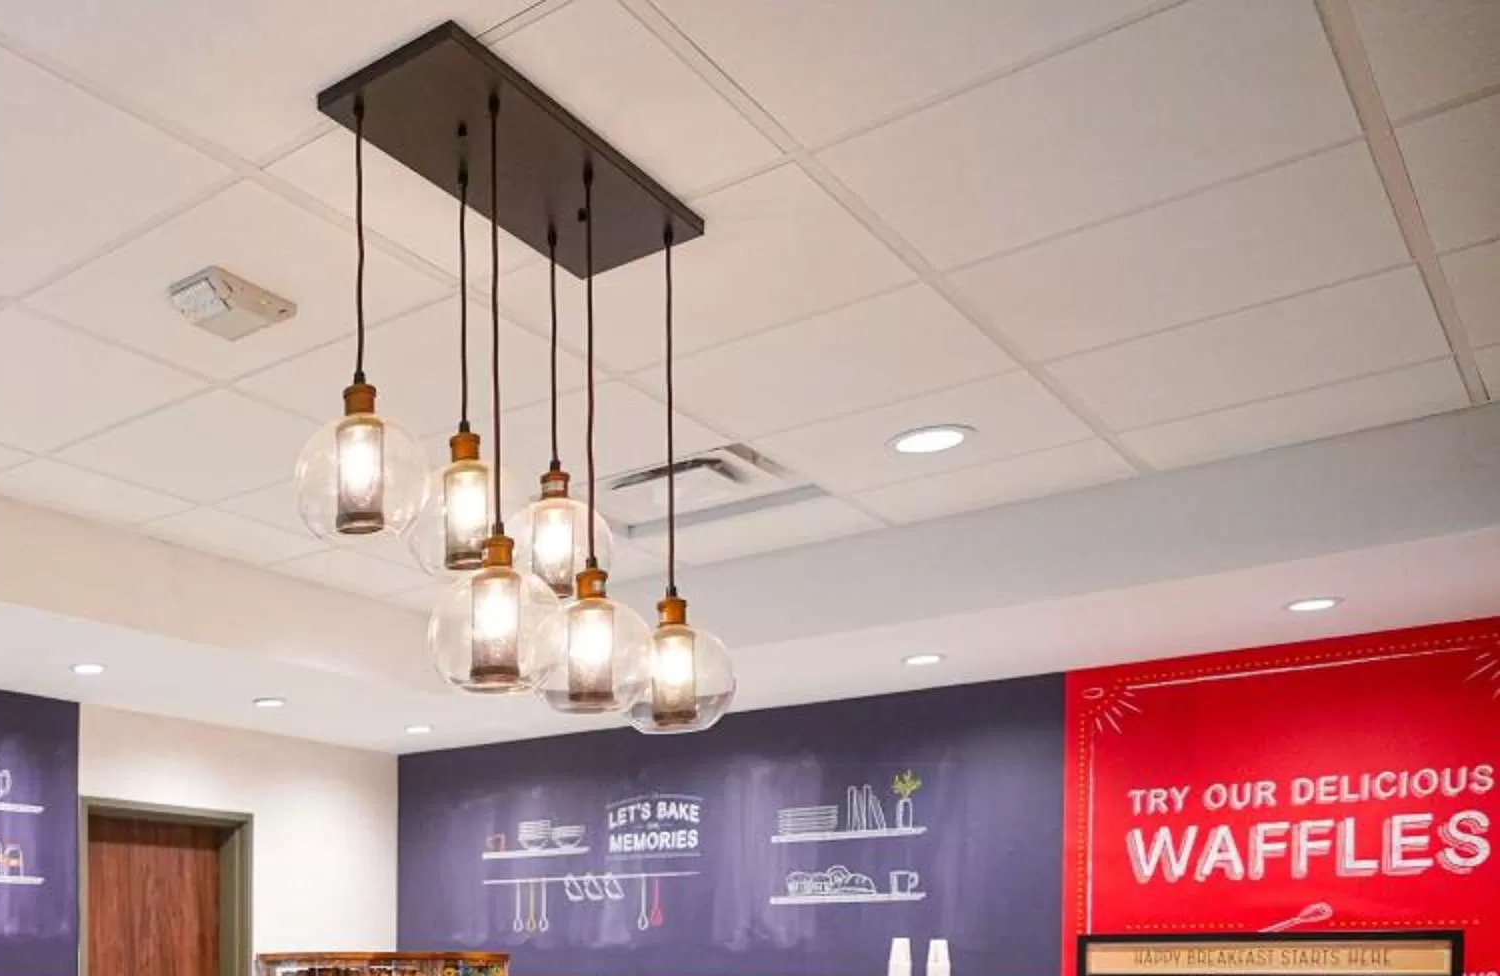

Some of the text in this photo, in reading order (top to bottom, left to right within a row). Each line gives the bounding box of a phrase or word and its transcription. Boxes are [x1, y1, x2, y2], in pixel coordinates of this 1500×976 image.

[1128, 764, 1495, 815] TRY OUR DELICIOUS
[608, 801, 700, 829] LET'S BAKE
[609, 829, 699, 853] MEMORIES
[1125, 809, 1492, 884] WAFFLES
[1134, 948, 1391, 967] HAPPY BREAKFAST STARTS HERE
